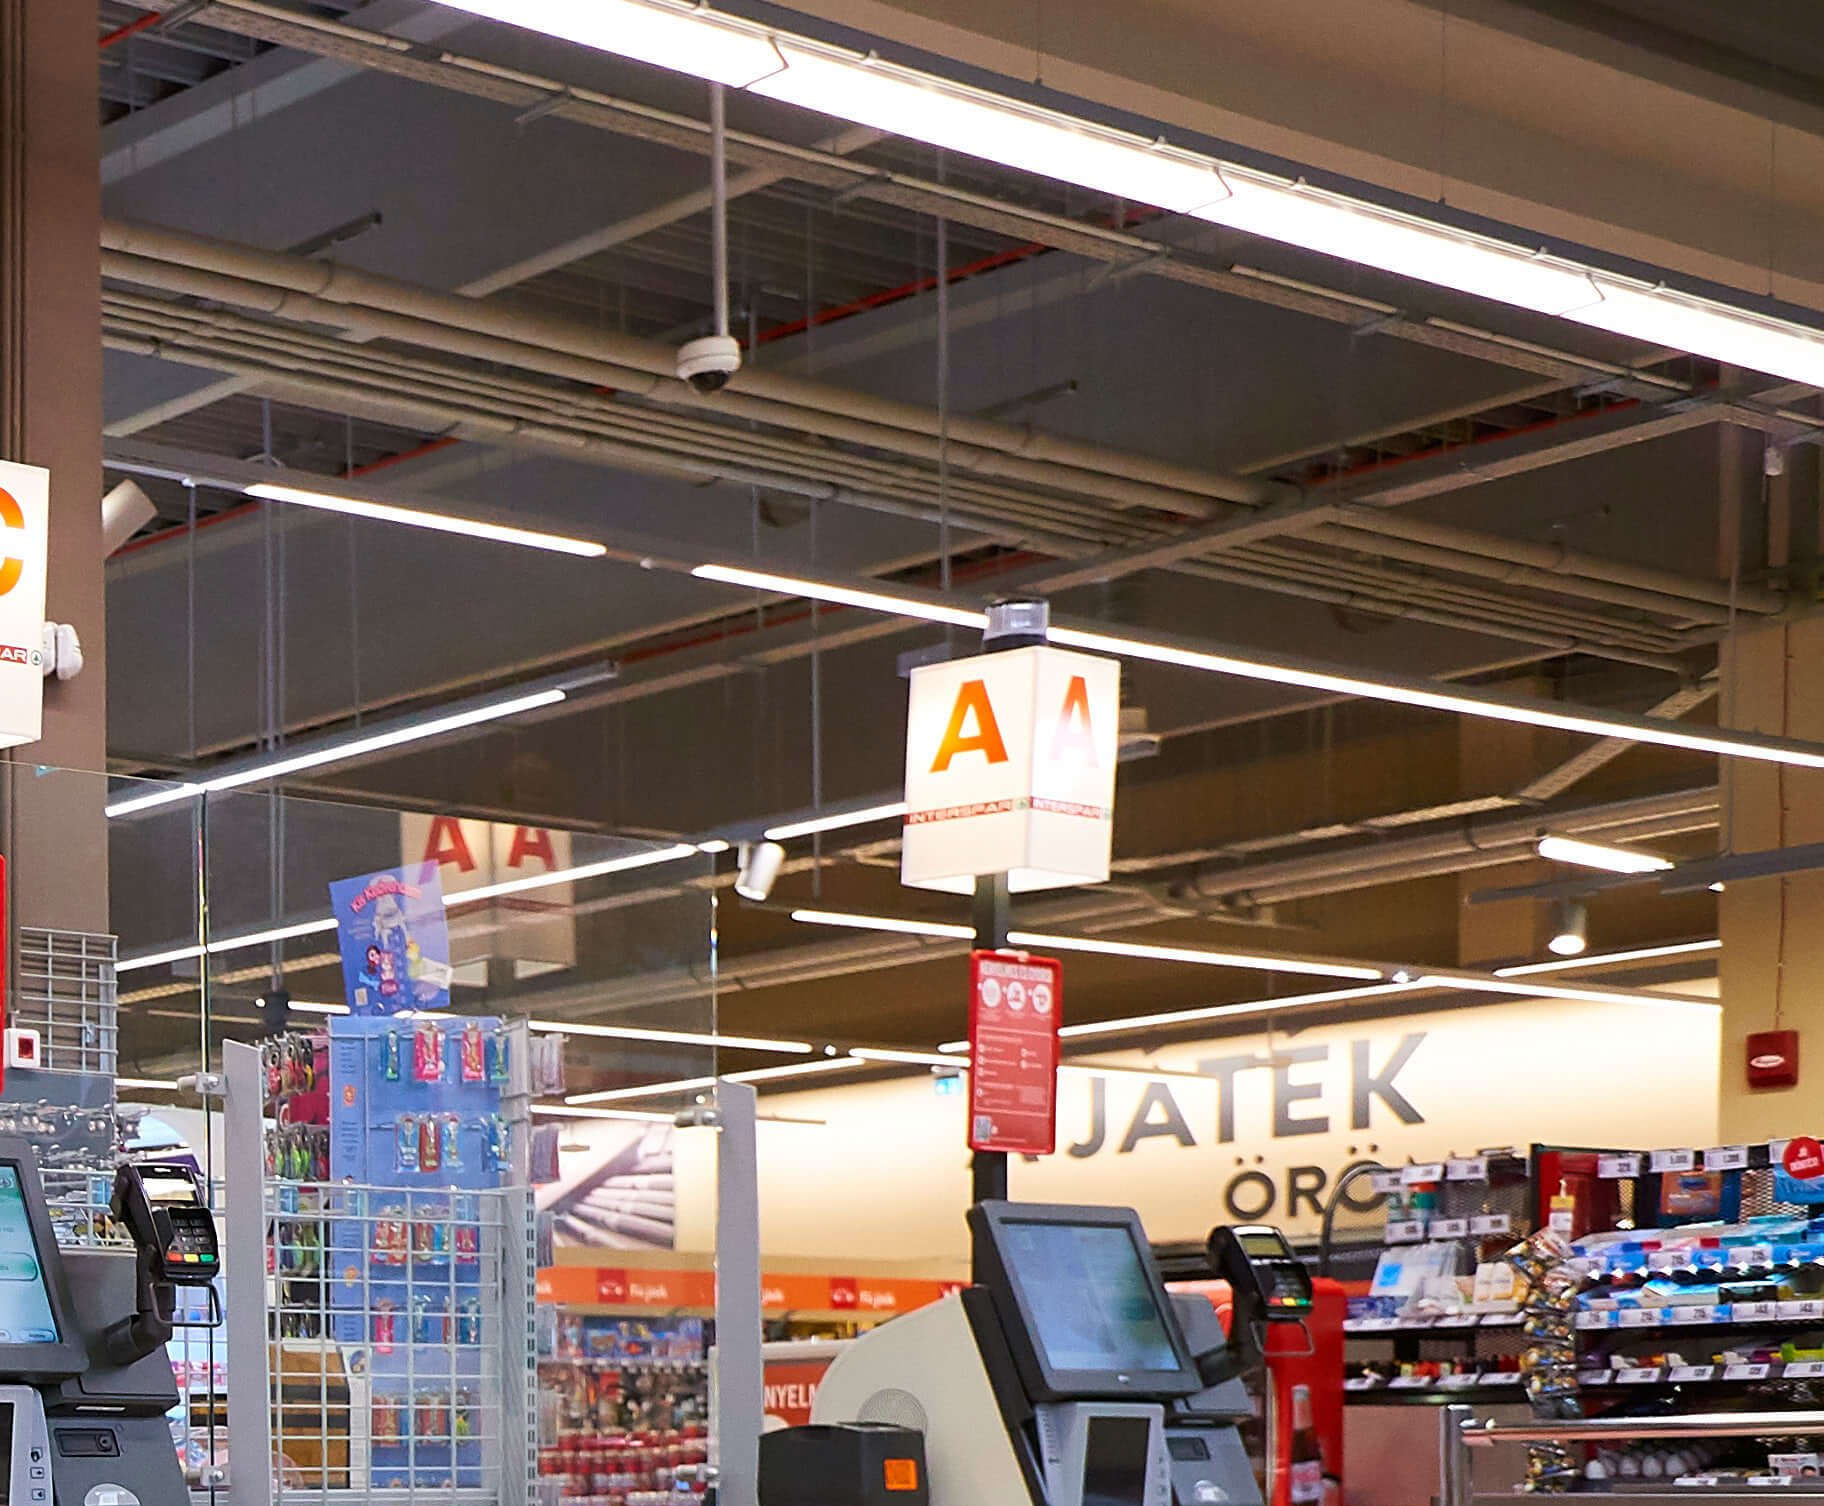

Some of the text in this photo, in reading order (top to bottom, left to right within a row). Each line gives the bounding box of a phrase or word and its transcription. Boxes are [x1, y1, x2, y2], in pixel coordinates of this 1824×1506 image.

[929, 679, 1009, 774] A
[909, 802, 1011, 824] INTERSPAR
[1032, 798, 1101, 818] INTERSPAR
[1225, 1144, 1387, 1221] ÖRÖ
